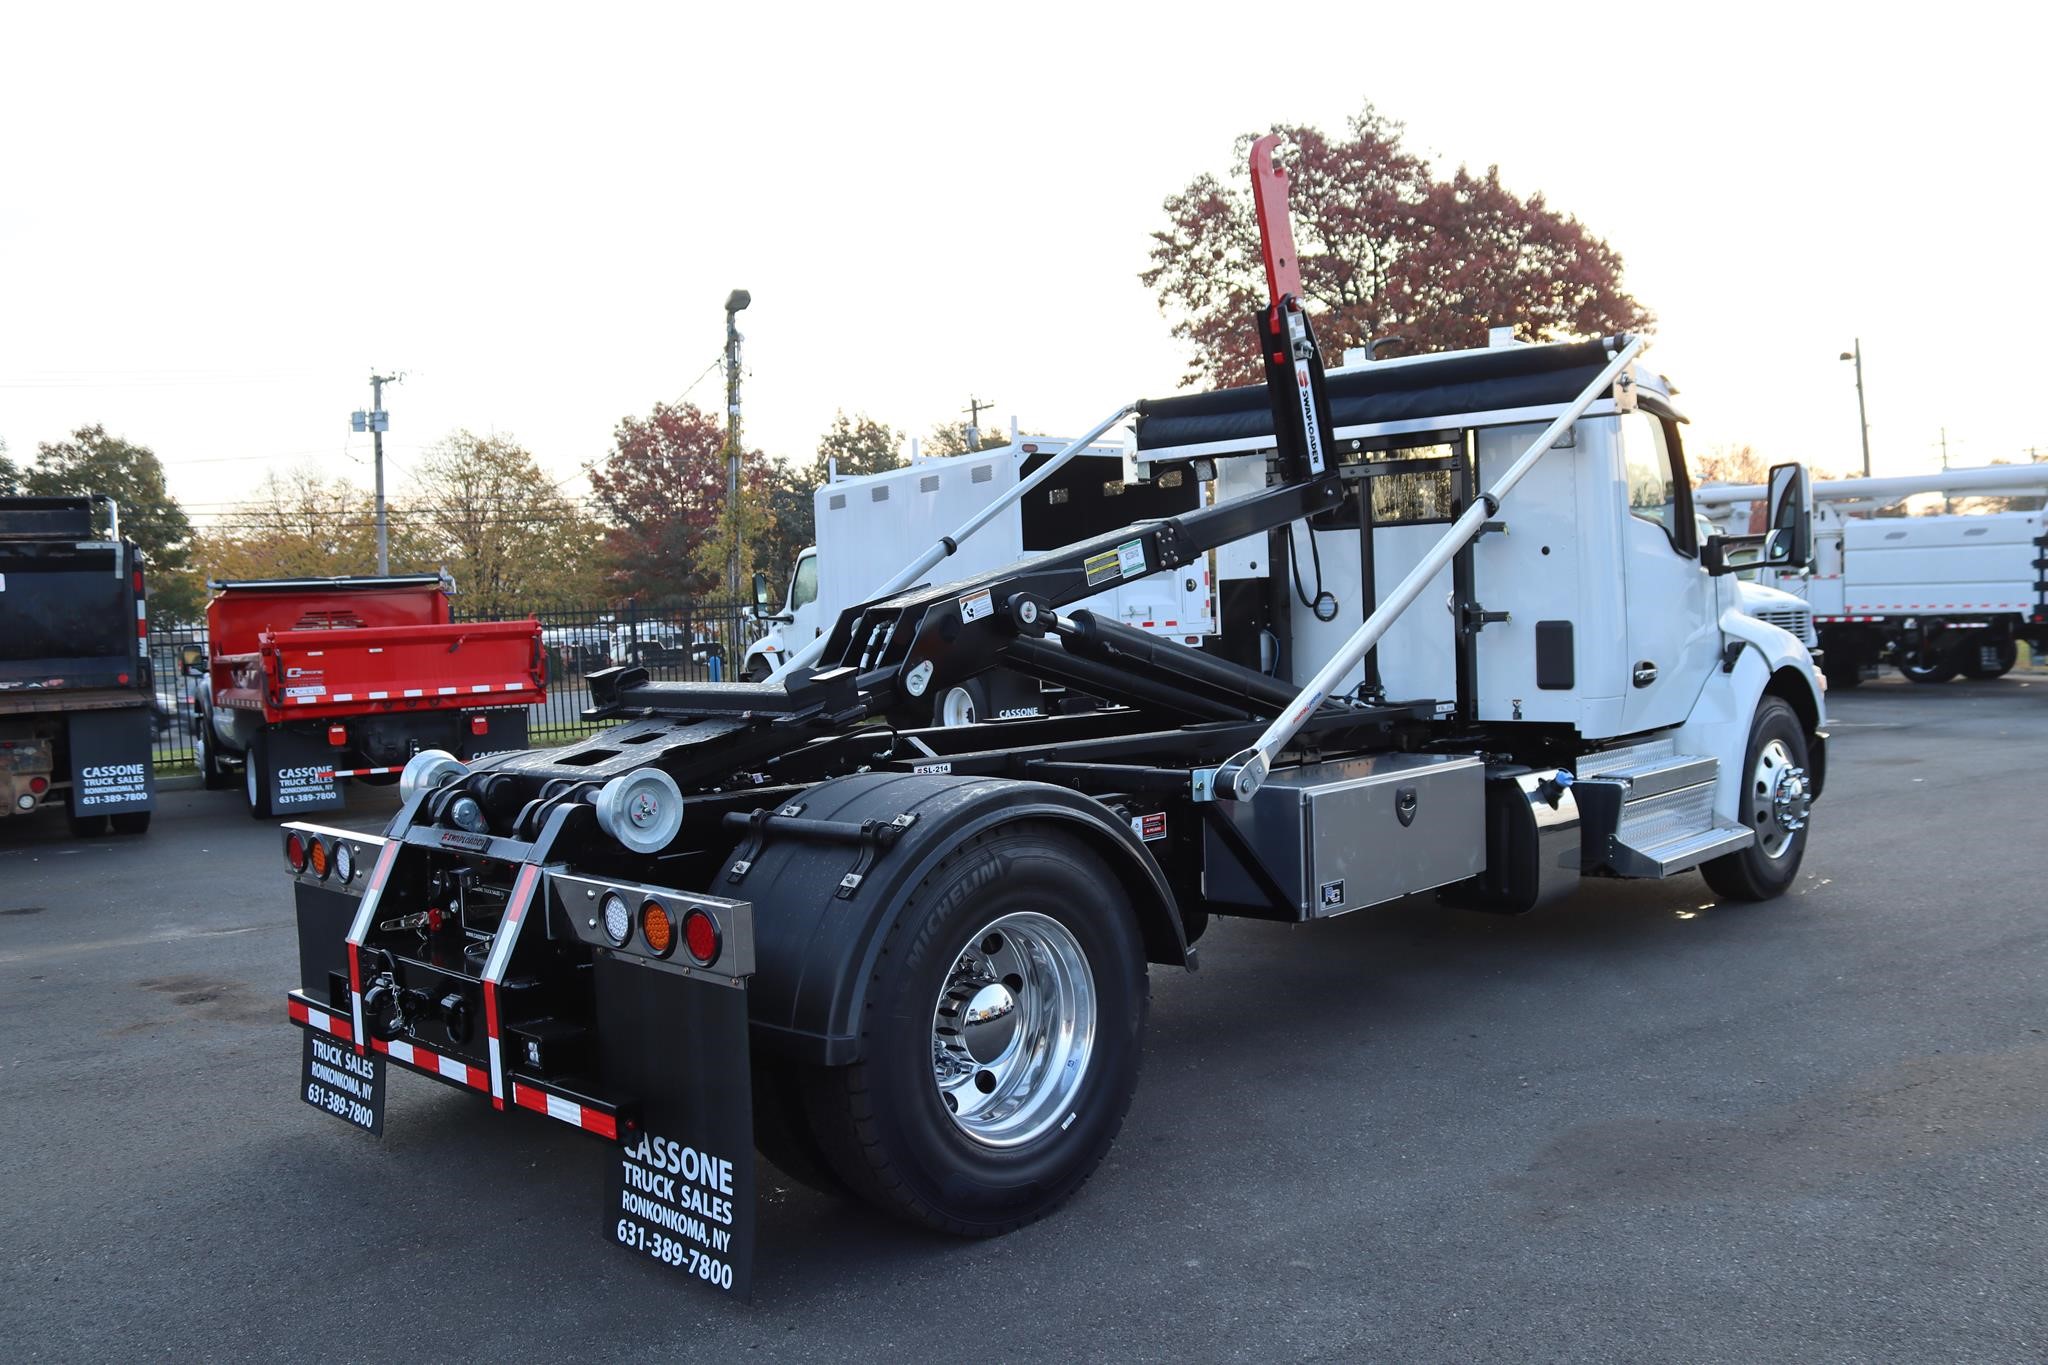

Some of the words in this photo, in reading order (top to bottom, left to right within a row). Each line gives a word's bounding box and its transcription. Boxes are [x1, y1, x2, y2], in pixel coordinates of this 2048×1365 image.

[1302, 390, 1319, 464] SWAPLOADER
[999, 707, 1039, 718] CASSONE
[82, 764, 144, 778] CASSONE
[83, 777, 115, 787] TRUCK
[117, 775, 145, 784] SALES
[279, 778, 307, 787] TRUCK
[923, 765, 949, 774] SL-214
[82, 792, 148, 805] 631-389-7800
[84, 785, 134, 795] RONKONKOMA,
[278, 792, 337, 804] 631-389-7800
[905, 856, 1004, 970] MICHELIN
[312, 1039, 342, 1067] TRUCK
[345, 1052, 374, 1080] SALES
[311, 1061, 361, 1099] RONKONKOMA,
[362, 1082, 373, 1101] NY
[308, 1083, 373, 1128] 631-389-7800
[622, 1160, 675, 1203] TRUCK
[681, 1184, 733, 1225] SALES
[622, 1190, 711, 1248] RONKONKOMA,
[712, 1227, 731, 1253] NY
[617, 1218, 733, 1290] 631-389-7800
